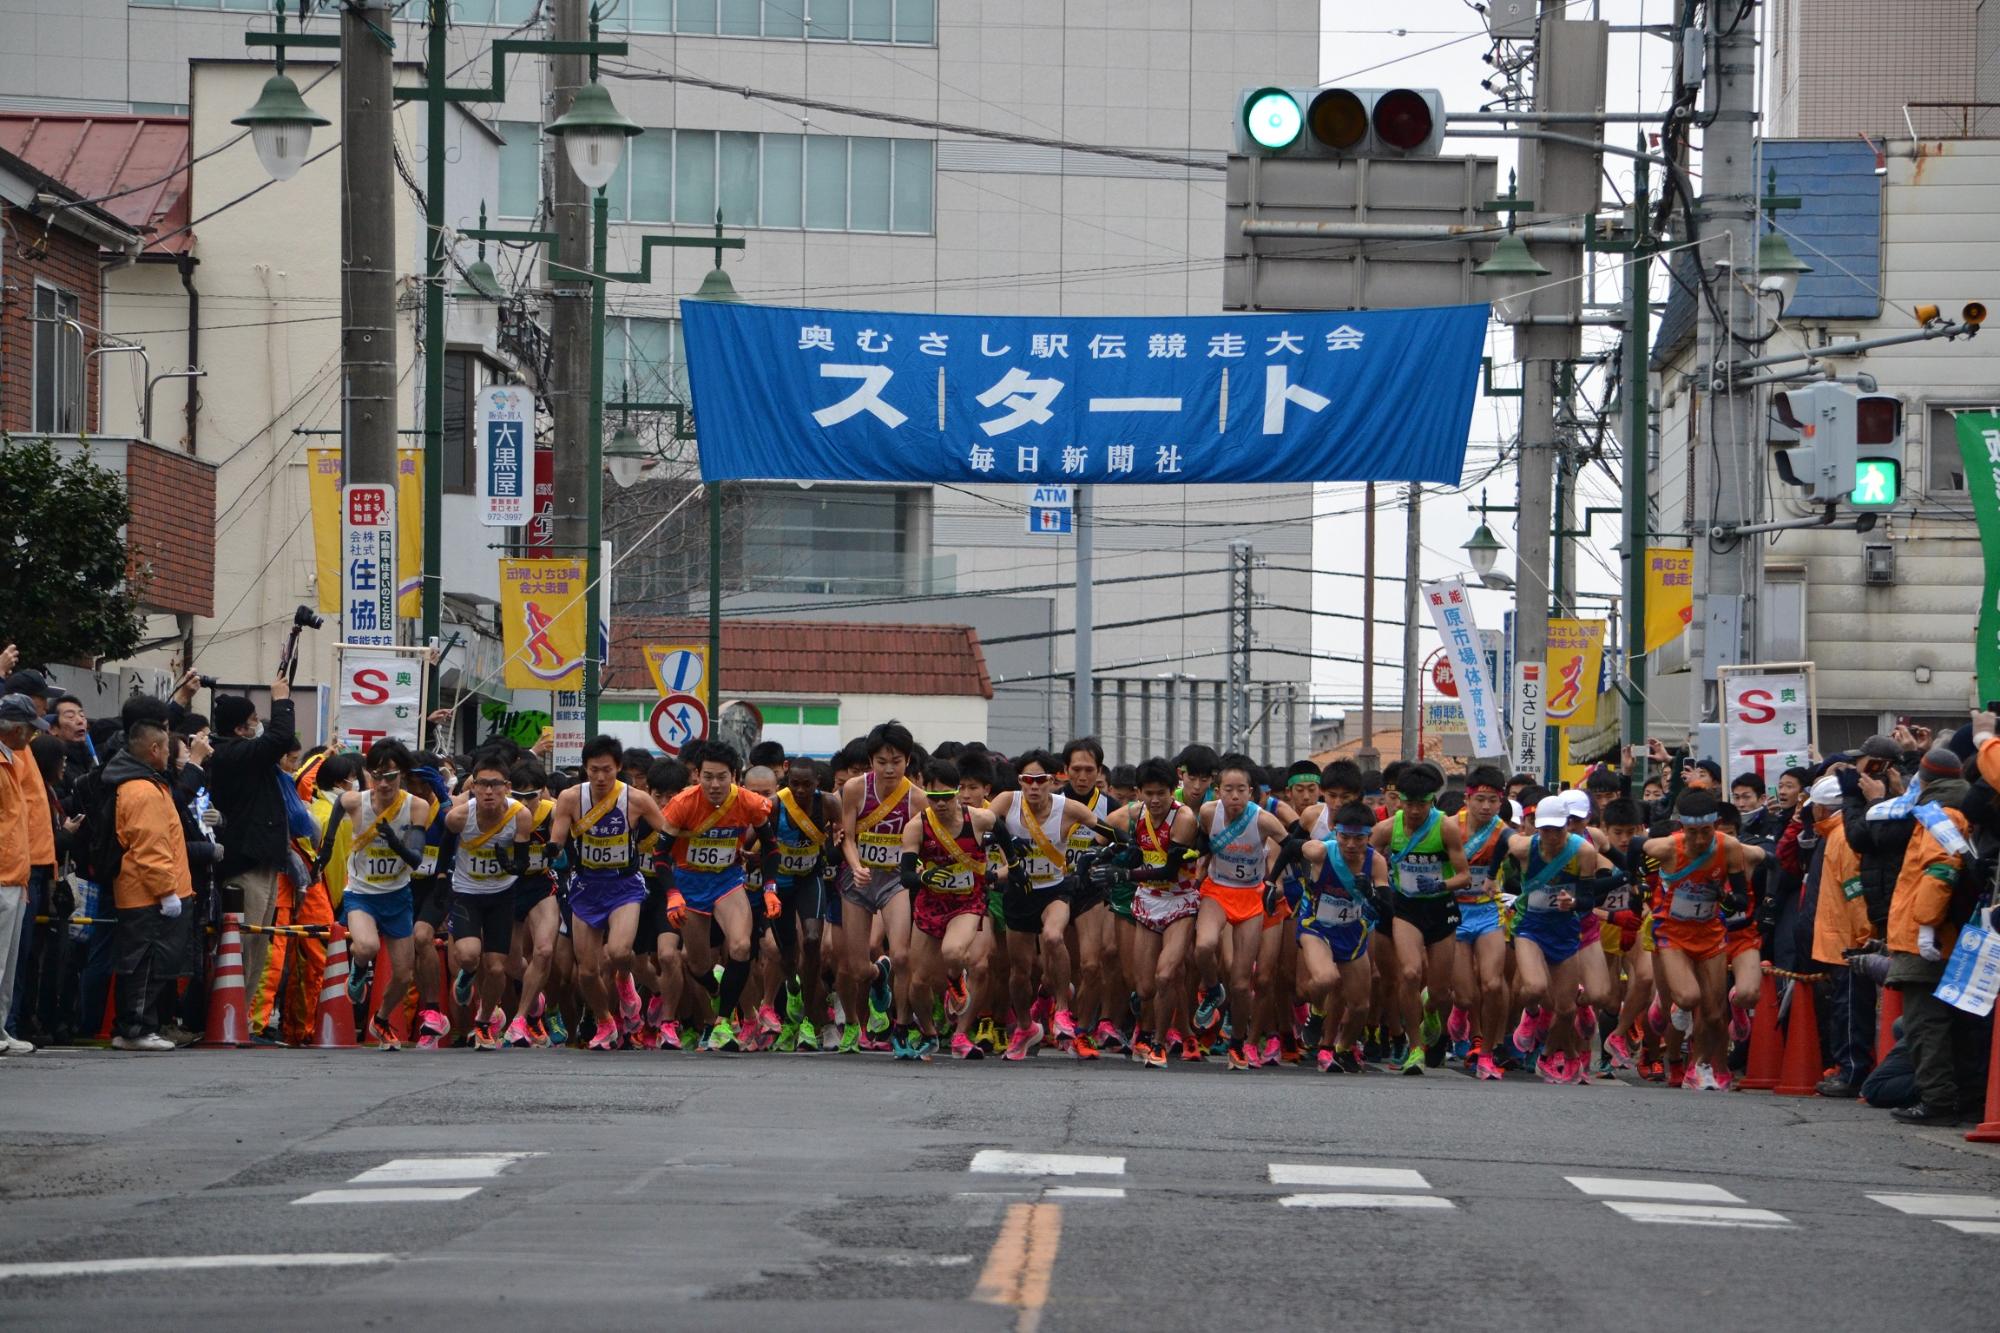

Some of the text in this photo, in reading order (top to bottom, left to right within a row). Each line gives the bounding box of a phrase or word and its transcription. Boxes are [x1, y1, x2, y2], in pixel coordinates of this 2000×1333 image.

[798, 324, 1365, 359] 奥むさし駅伝競走大会
[812, 363, 1331, 437] スタート
[493, 422, 518, 496] 大黒屋
[968, 443, 1182, 474] 毎日新聞社
[1034, 488, 1067, 502] ATM
[351, 558, 376, 631] 住協
[1443, 607, 1488, 749] 原市場体育協会
[1521, 682, 1538, 765] むさし証券
[584, 845, 626, 862] 105-1
[690, 848, 732, 864] 156-1
[860, 843, 900, 863] 103-1
[368, 858, 397, 875] 107
[470, 857, 499, 874] 115
[1235, 864, 1257, 879] 5-1
[1338, 908, 1360, 921] 4-1
